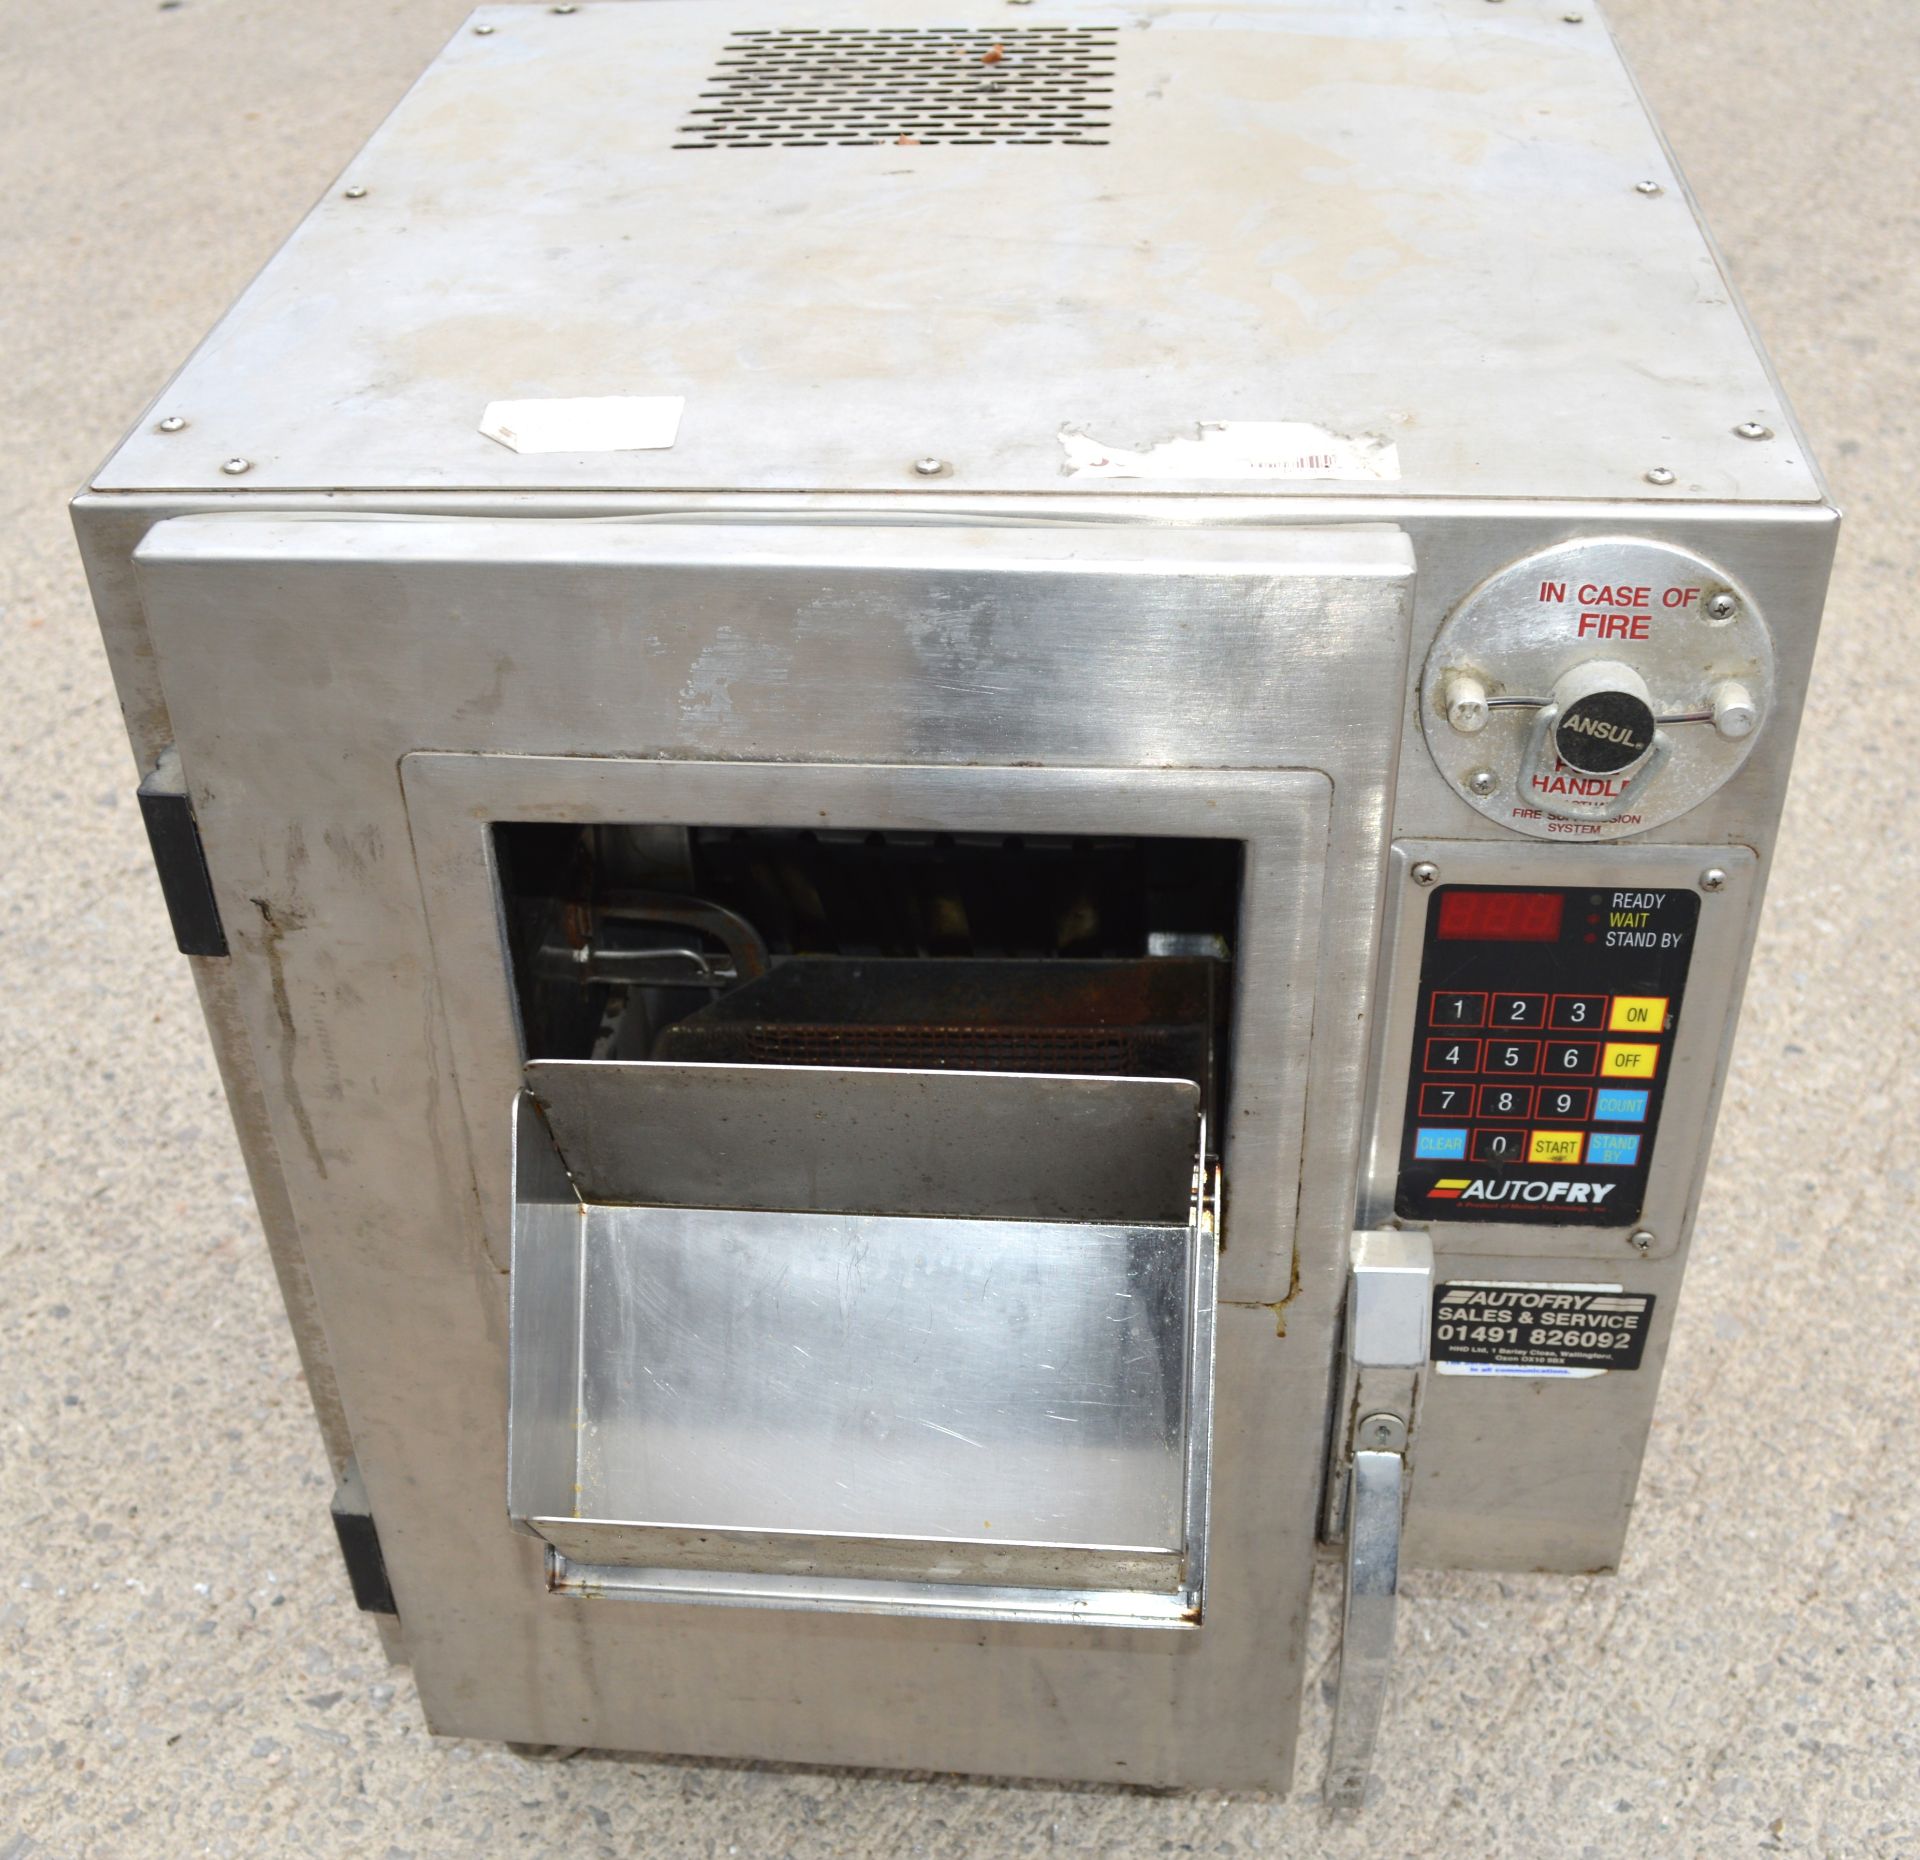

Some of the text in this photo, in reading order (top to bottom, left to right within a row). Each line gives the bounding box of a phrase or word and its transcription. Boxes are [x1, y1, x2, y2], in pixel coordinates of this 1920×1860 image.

[1539, 582, 1700, 608] IN CASE OF
[1577, 613, 1652, 640] FIRE
[1562, 713, 1636, 749] ANSUL
[1512, 808, 1542, 820] FIRE
[1548, 823, 1601, 835] SYSTEM
[1612, 892, 1666, 909] READY
[1609, 912, 1650, 928] WAIT
[1605, 931, 1682, 948] STAND BY
[1453, 1000, 1463, 1019] 1
[1510, 1001, 1527, 1021] 2
[1570, 1002, 1586, 1022] 3
[1627, 1007, 1648, 1023] ON
[1446, 1046, 1460, 1065] 4
[1504, 1047, 1519, 1066] 5
[1563, 1049, 1578, 1068] 6
[1615, 1053, 1641, 1068] OFF
[1441, 1091, 1455, 1109] 7
[1498, 1092, 1513, 1111] 8
[1556, 1094, 1572, 1113] 9
[1599, 1097, 1643, 1113] COUNT
[1420, 1136, 1463, 1150] CLEAR
[1492, 1136, 1506, 1155] 0
[1535, 1140, 1578, 1154] START
[1593, 1135, 1637, 1150] STAND
[1603, 1150, 1621, 1163] BY
[1461, 1179, 1616, 1203] AUTOFRY
[1468, 1291, 1592, 1310] AUTOFRY
[1437, 1308, 1639, 1329] SALES & SERVICE
[1437, 1324, 1631, 1349] 01491 826092
